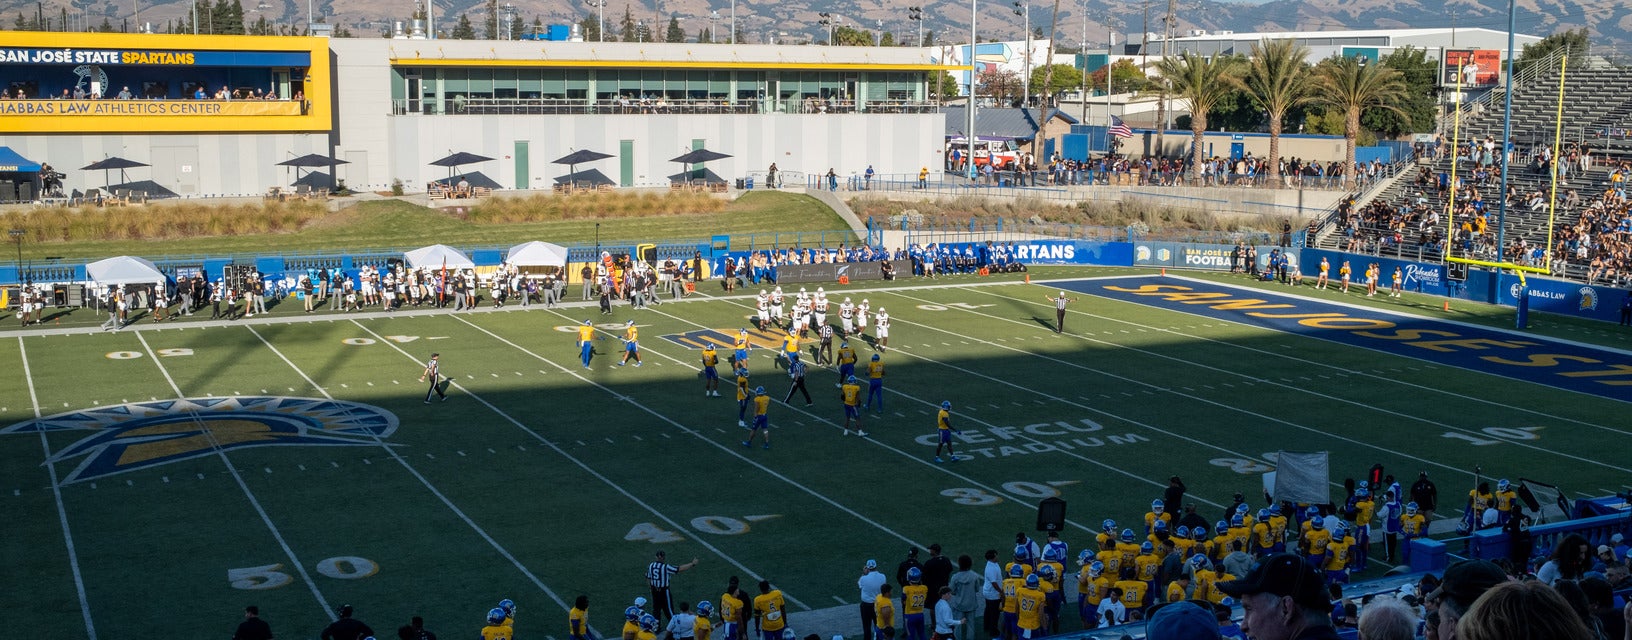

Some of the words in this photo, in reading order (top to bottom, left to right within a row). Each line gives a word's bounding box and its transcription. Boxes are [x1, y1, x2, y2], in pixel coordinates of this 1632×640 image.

[32, 49, 73, 63] JOSÉ
[75, 51, 119, 64] STATE
[122, 51, 195, 65] SPARTANS
[60, 103, 91, 114] LAW
[94, 103, 166, 114] ATHLETICS
[170, 103, 221, 114] CENTER
[1449, 262, 1465, 278] 24
[1103, 285, 1296, 310] SAN
[1551, 291, 1566, 300] LAW
[914, 418, 1103, 447] CEFCU
[947, 433, 1150, 461] STADIUM
[940, 481, 1061, 506] 30
[624, 516, 751, 543] 40
[228, 556, 380, 590] 50
[652, 568, 660, 580] S
[769, 602, 777, 612] 5
[912, 595, 925, 608] 22
